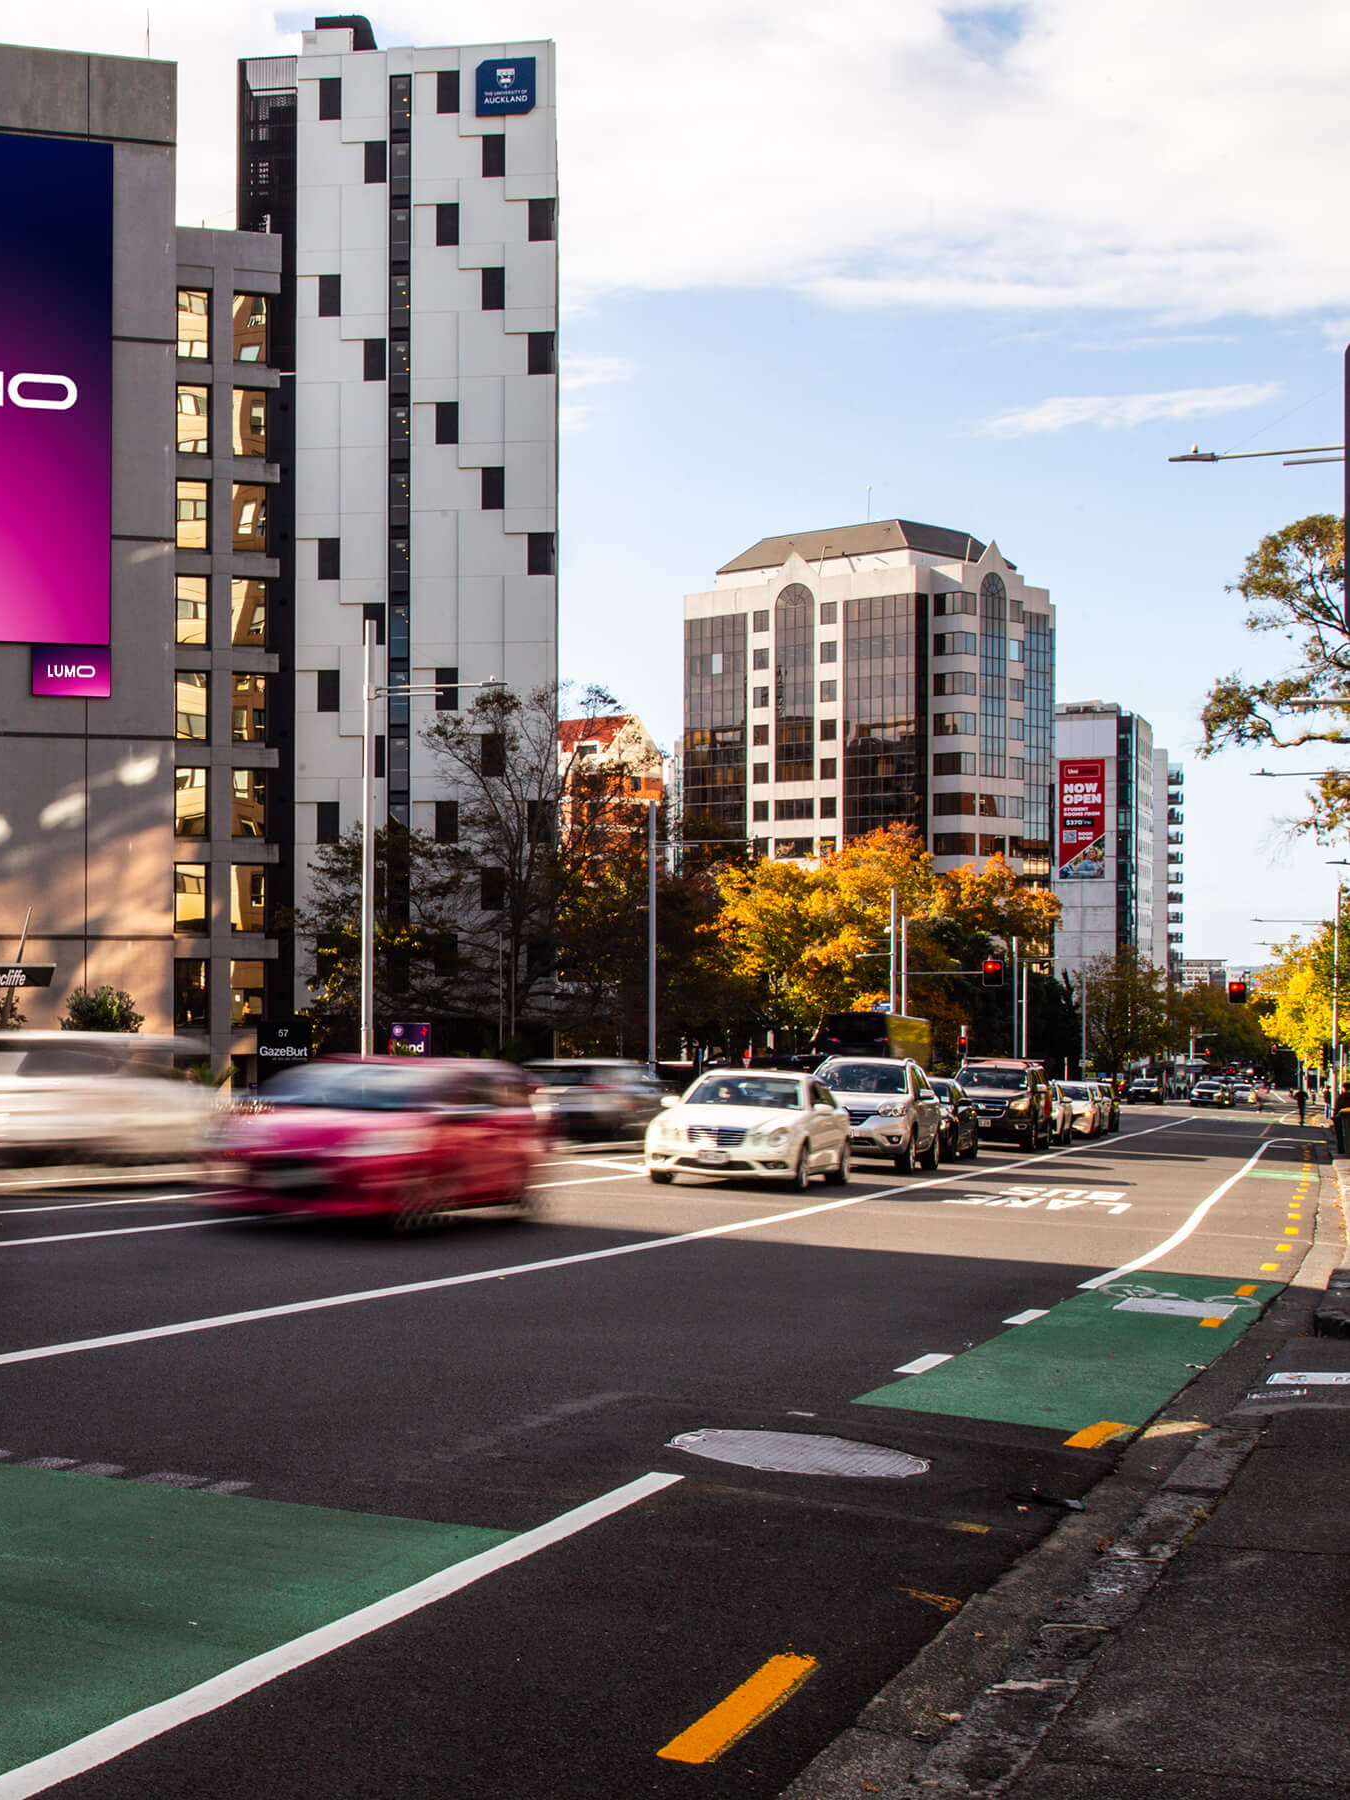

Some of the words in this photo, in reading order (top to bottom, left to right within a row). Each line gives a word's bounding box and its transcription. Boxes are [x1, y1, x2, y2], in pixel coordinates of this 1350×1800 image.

[484, 95, 528, 104] AUCKLAND
[47, 665, 96, 678] LUMO
[1063, 783, 1098, 794] NOW
[1063, 793, 1102, 805] OPEN
[277, 1029, 289, 1038] 57
[259, 1046, 308, 1057] GazeBurt
[998, 1186, 1128, 1201] BUS
[942, 1193, 1133, 1215] LANE
